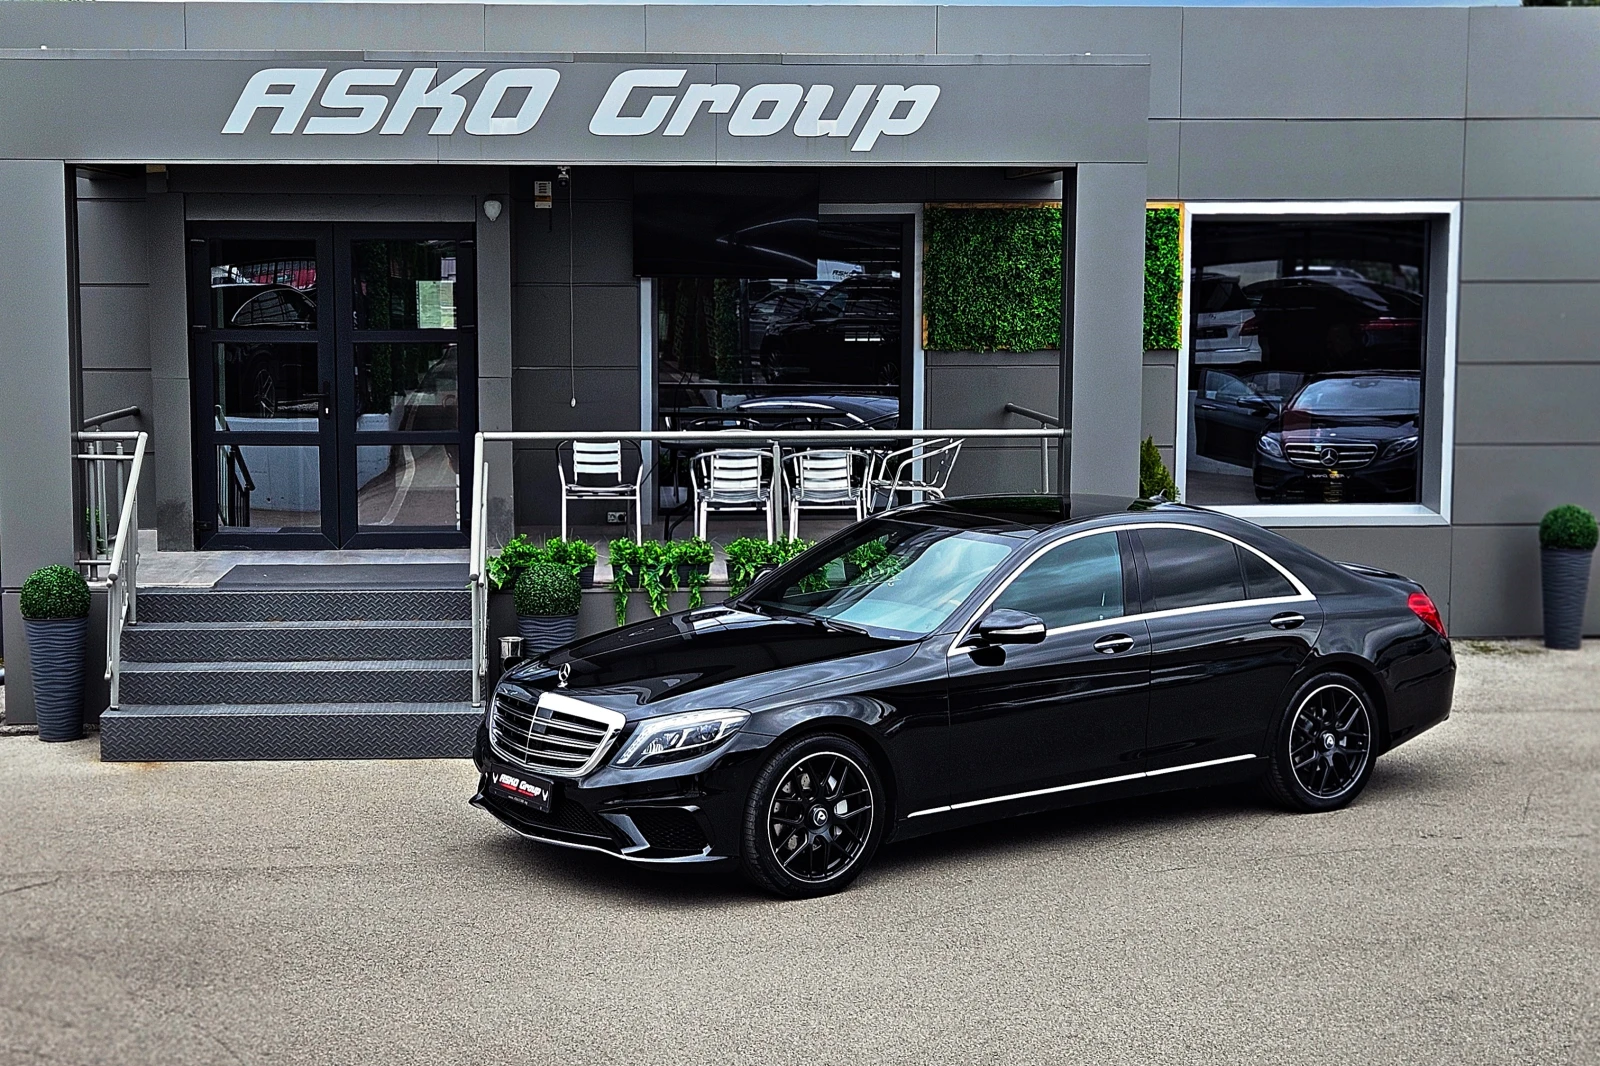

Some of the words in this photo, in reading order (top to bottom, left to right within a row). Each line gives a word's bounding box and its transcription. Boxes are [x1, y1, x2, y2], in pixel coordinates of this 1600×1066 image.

[221, 68, 561, 136] ASKO
[588, 68, 941, 152] Group
[499, 773, 520, 788] ASKO
[519, 780, 542, 797] Group
